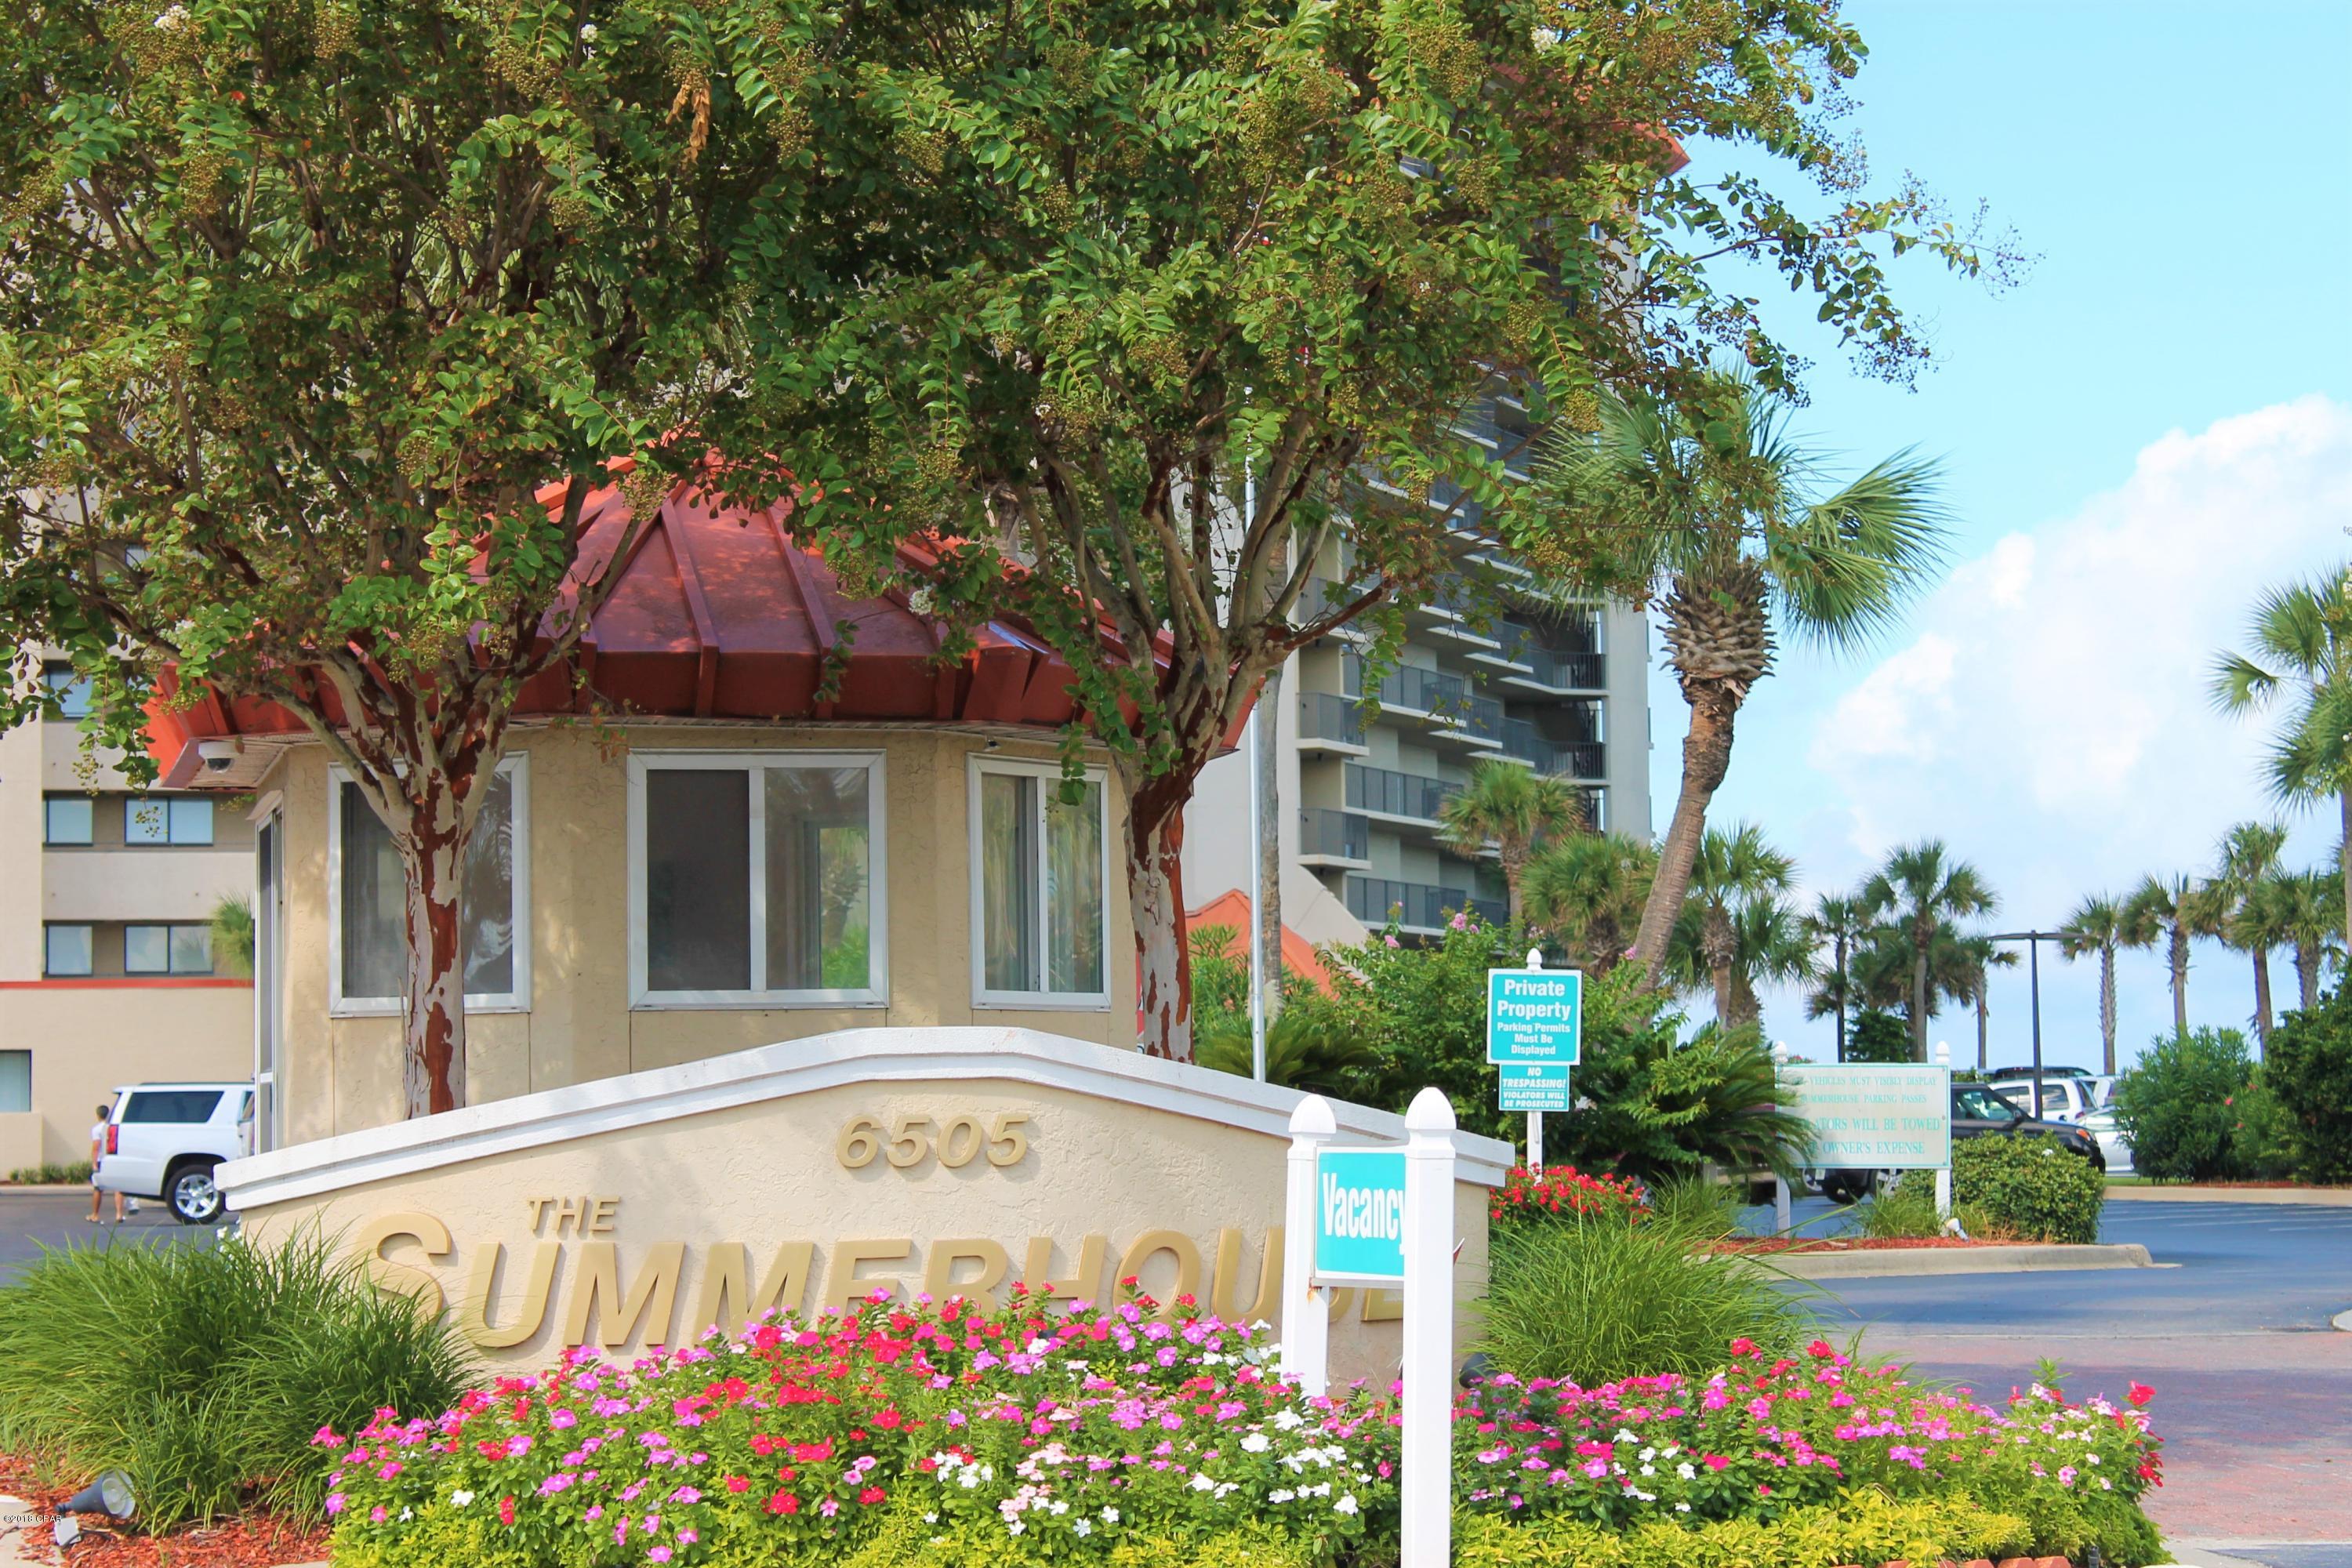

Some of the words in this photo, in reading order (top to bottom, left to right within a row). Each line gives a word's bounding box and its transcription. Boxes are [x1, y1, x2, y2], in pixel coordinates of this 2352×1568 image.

[1504, 978, 1565, 996] Private
[1497, 1000, 1571, 1021] Property
[1497, 1022, 1533, 1034] Parking
[1534, 1022, 1570, 1033] Permits
[1514, 1033, 1538, 1043] Must
[1541, 1034, 1553, 1044] Be
[1511, 1044, 1556, 1056] Displayed
[1527, 1066, 1542, 1076] NO
[1503, 1078, 1566, 1088] TRESPASSING!
[1809, 1076, 1846, 1086] VEHICLES
[1849, 1076, 1871, 1086] MUST
[1875, 1076, 1902, 1086] VISIBLY
[1906, 1076, 1938, 1086] DISPLAY
[1503, 1091, 1545, 1099] VIOLATORS
[1864, 1094, 1897, 1104] PARKING
[1901, 1094, 1928, 1104] PASSES
[1504, 1099, 1514, 1108] BE
[1515, 1099, 1565, 1108] PROSECUTED
[1852, 1117, 1878, 1131] WILL
[1883, 1117, 1897, 1131] BE
[1901, 1117, 1940, 1131] TOWED
[836, 1113, 1030, 1168] 6505
[1822, 1141, 1871, 1155] OWNER'S
[1876, 1141, 1926, 1155] EXPENSE
[528, 1196, 620, 1232] THE
